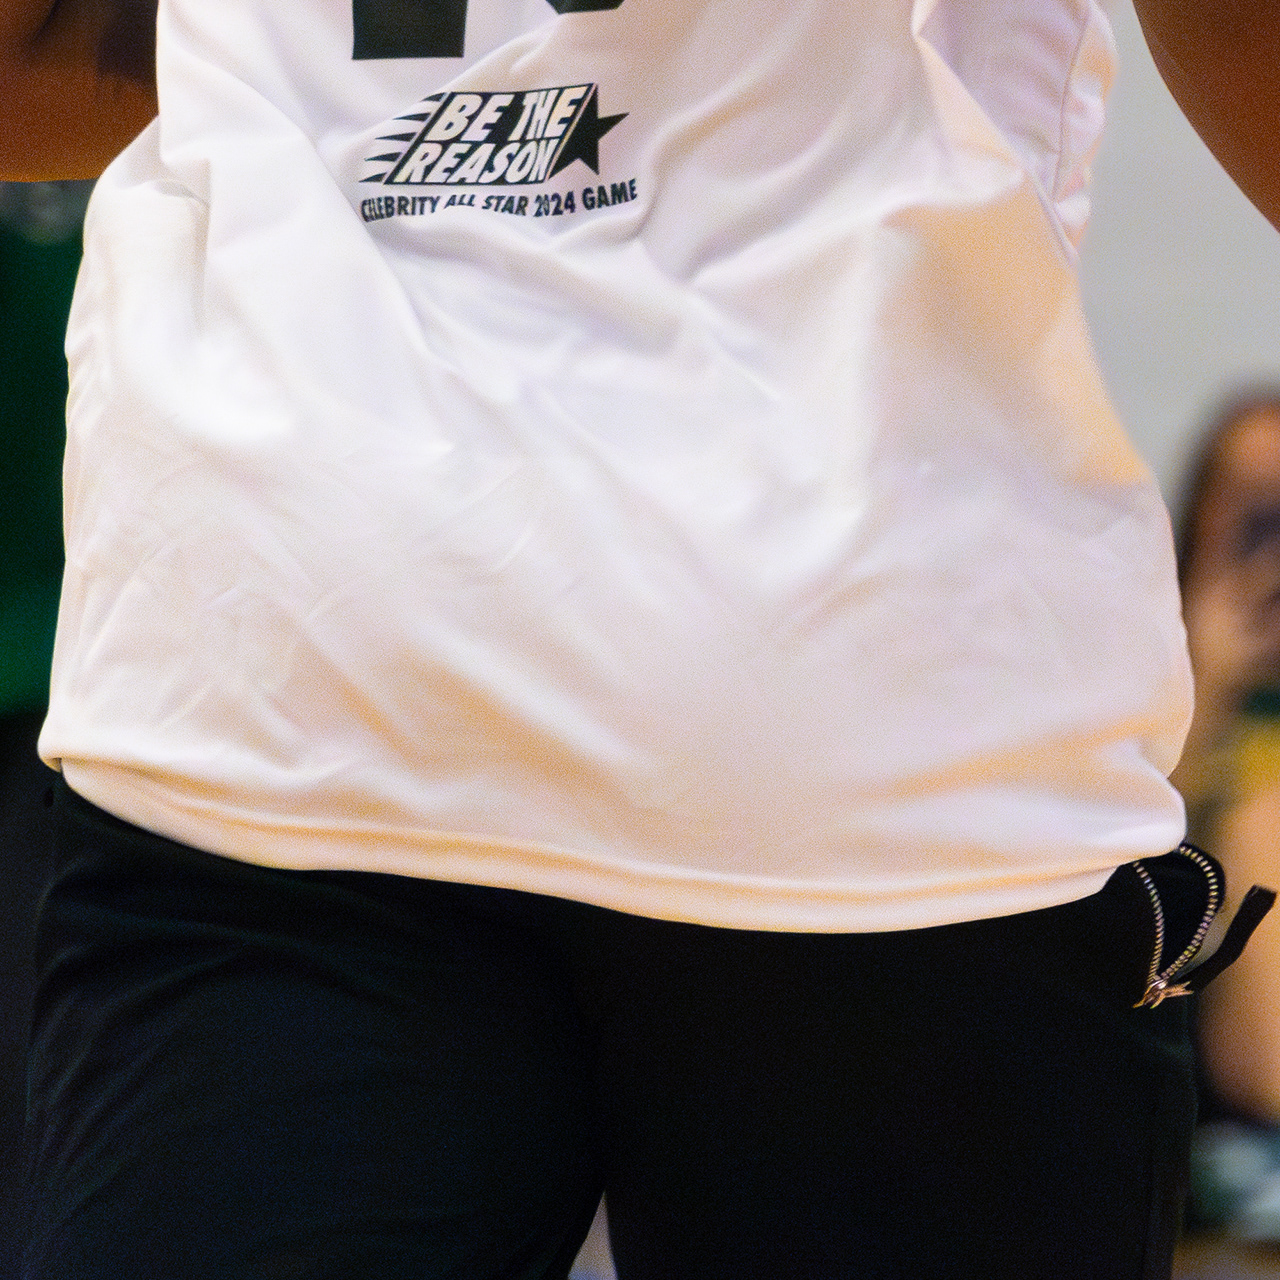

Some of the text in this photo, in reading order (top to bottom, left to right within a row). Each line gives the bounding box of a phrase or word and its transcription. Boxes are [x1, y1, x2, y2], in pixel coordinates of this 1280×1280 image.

[423, 85, 589, 142] BE THE
[392, 138, 561, 184] REASON
[444, 193, 476, 209] ALL
[481, 194, 529, 217] STAR
[533, 190, 577, 217] 2024
[581, 178, 638, 211] GAME
